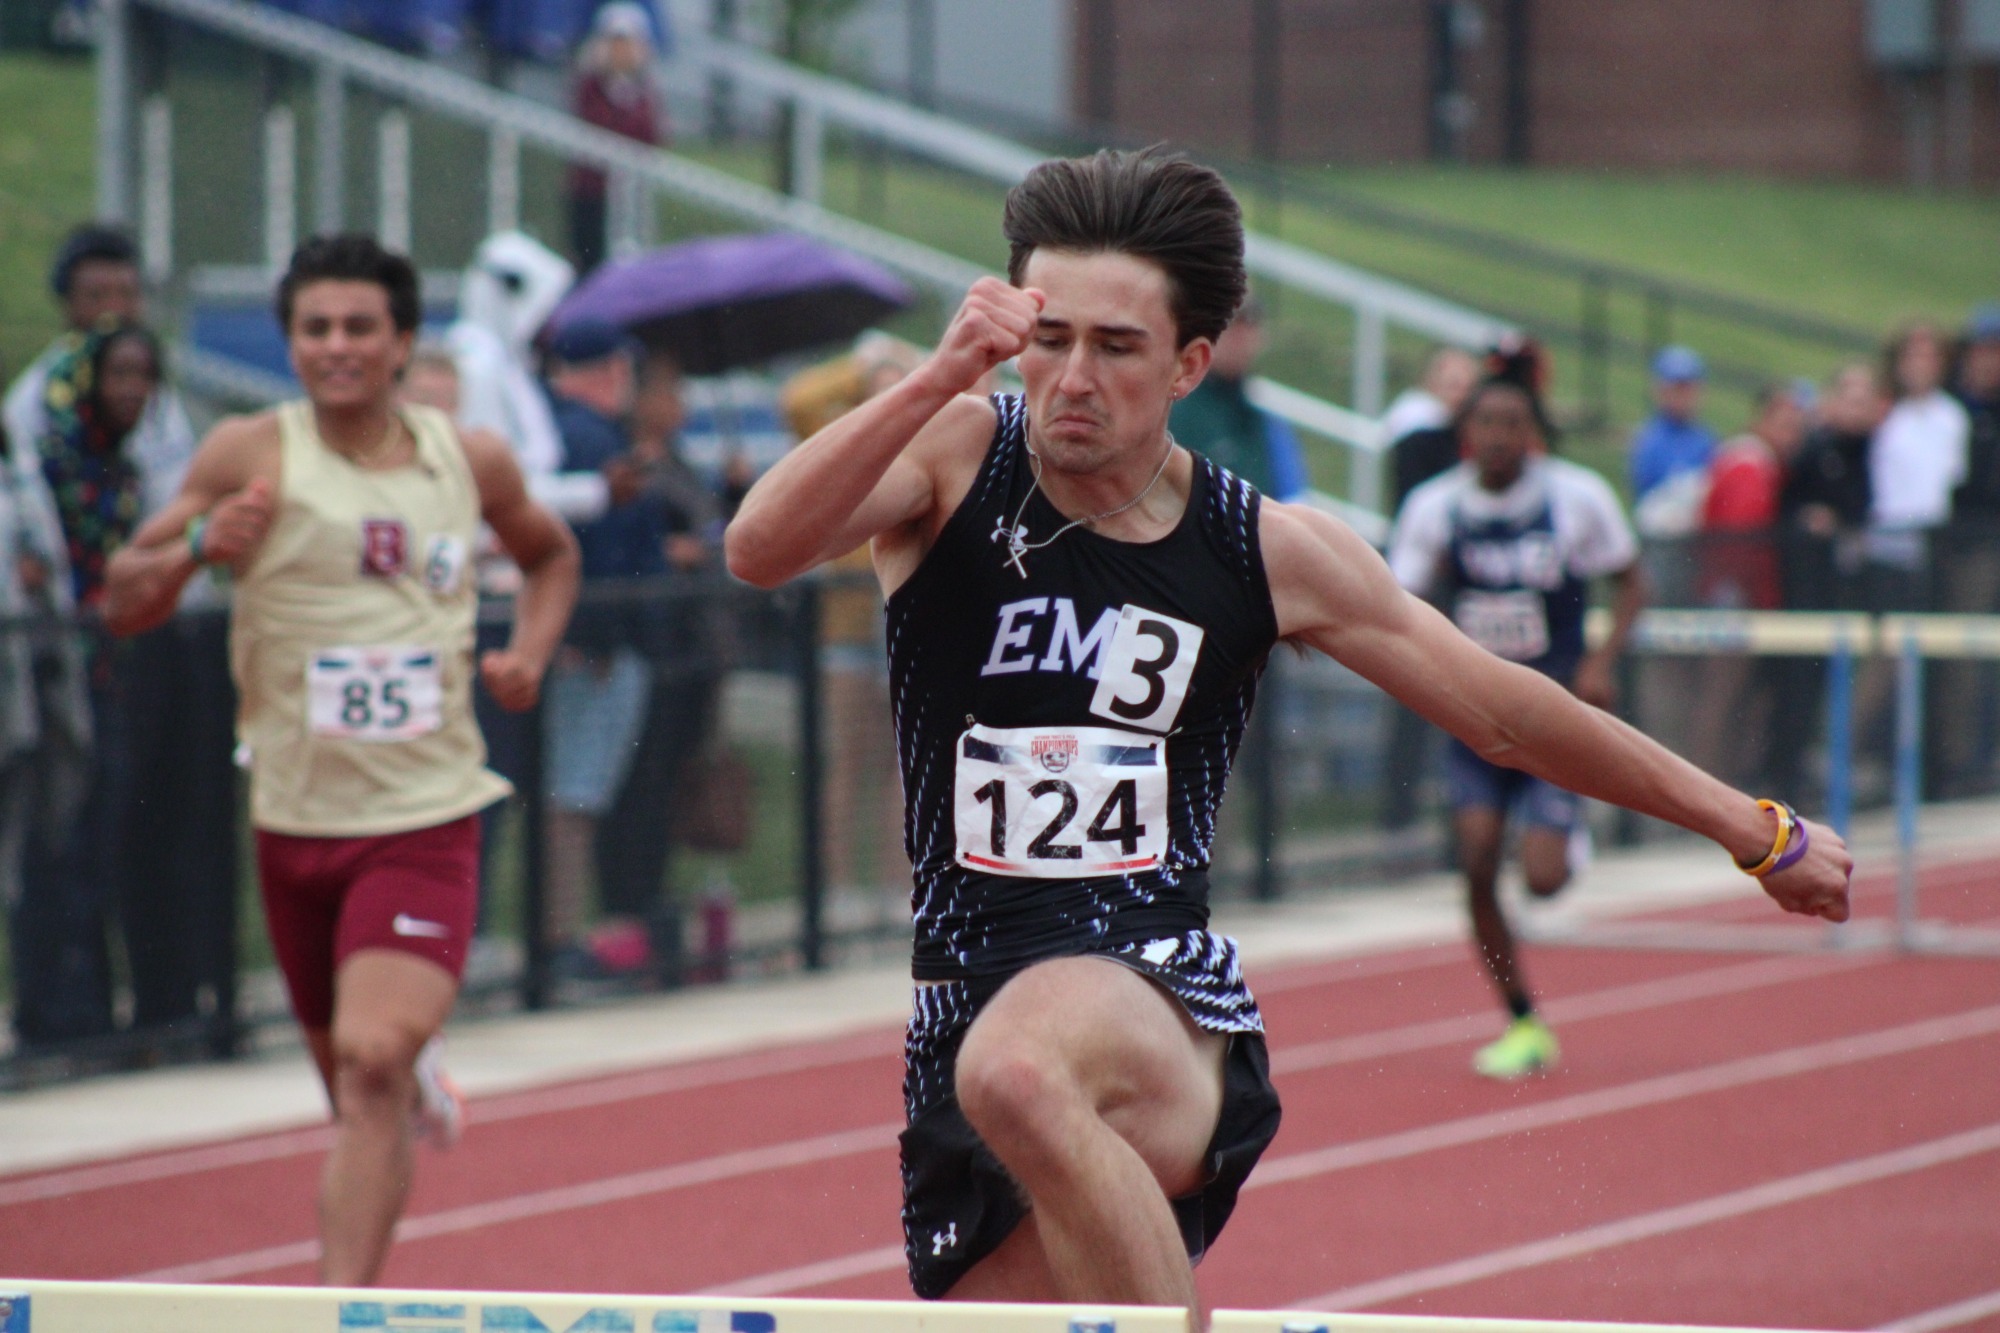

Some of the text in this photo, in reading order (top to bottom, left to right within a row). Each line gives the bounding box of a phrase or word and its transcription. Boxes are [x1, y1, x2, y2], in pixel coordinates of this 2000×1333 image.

[427, 540, 450, 585] 6
[1108, 619, 1180, 720] 3
[341, 679, 410, 728] 85
[1031, 740, 1078, 756] CHAMPIONSHIPS
[973, 778, 1146, 859] 124
